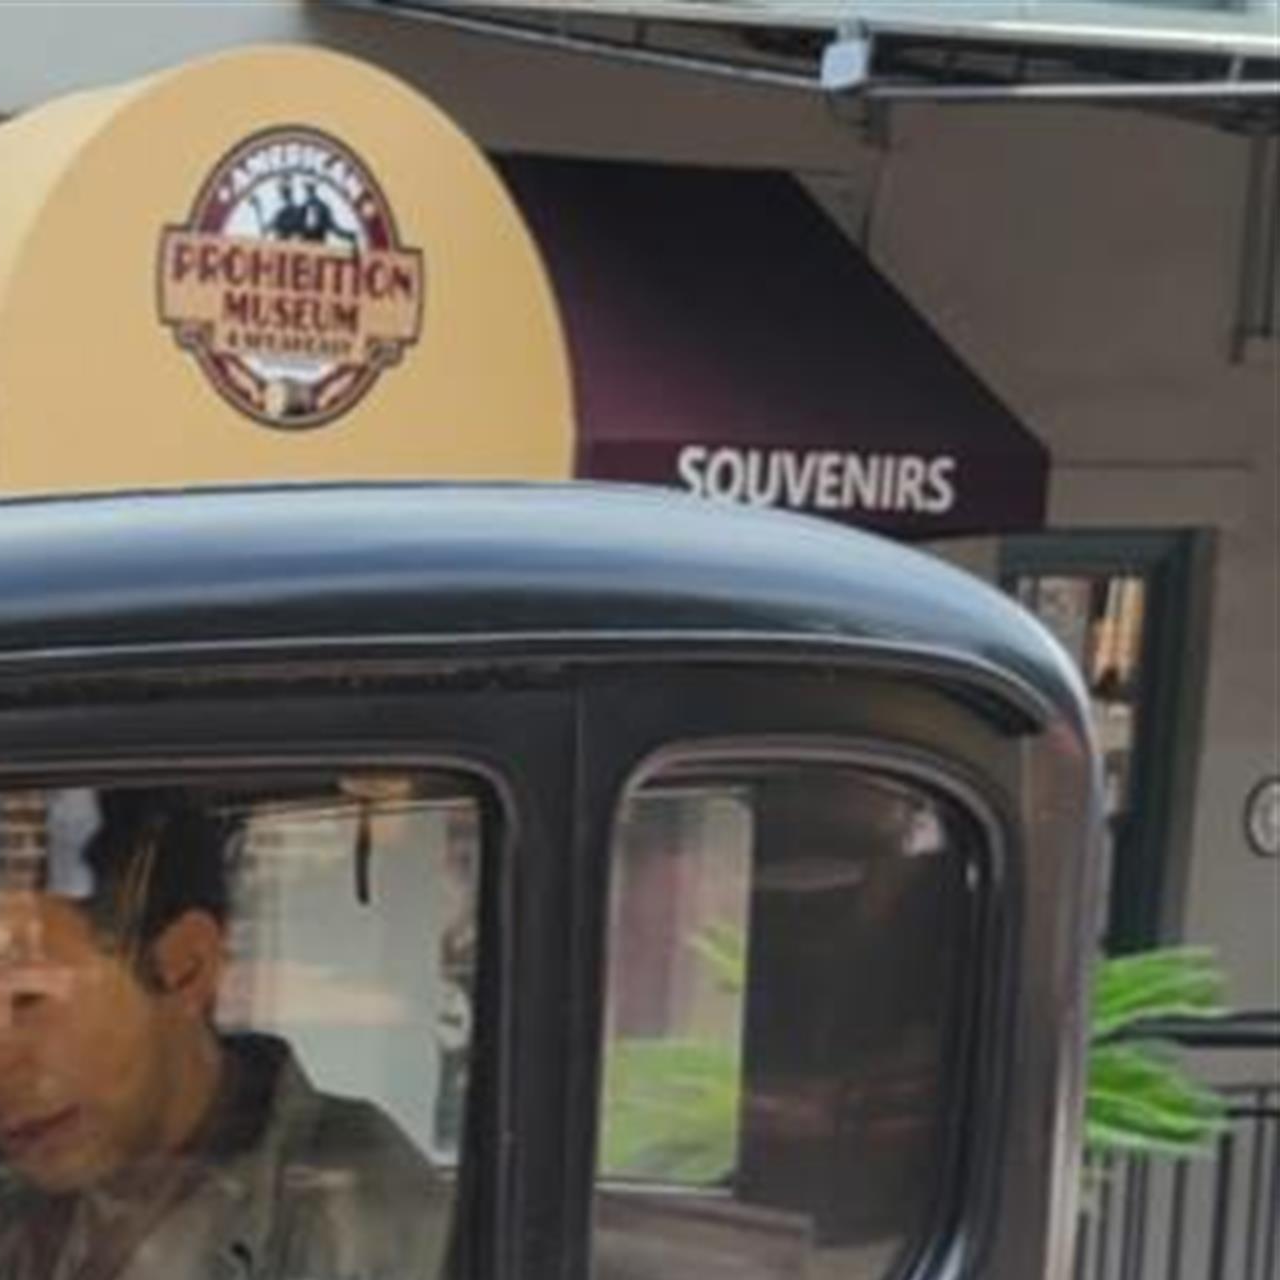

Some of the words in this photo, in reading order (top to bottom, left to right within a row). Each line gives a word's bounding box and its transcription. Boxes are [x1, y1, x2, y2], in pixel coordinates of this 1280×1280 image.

[170, 242, 413, 300] PROHIBITION
[222, 291, 359, 333] MUSEUM
[677, 446, 957, 513] SOUVENIRS
